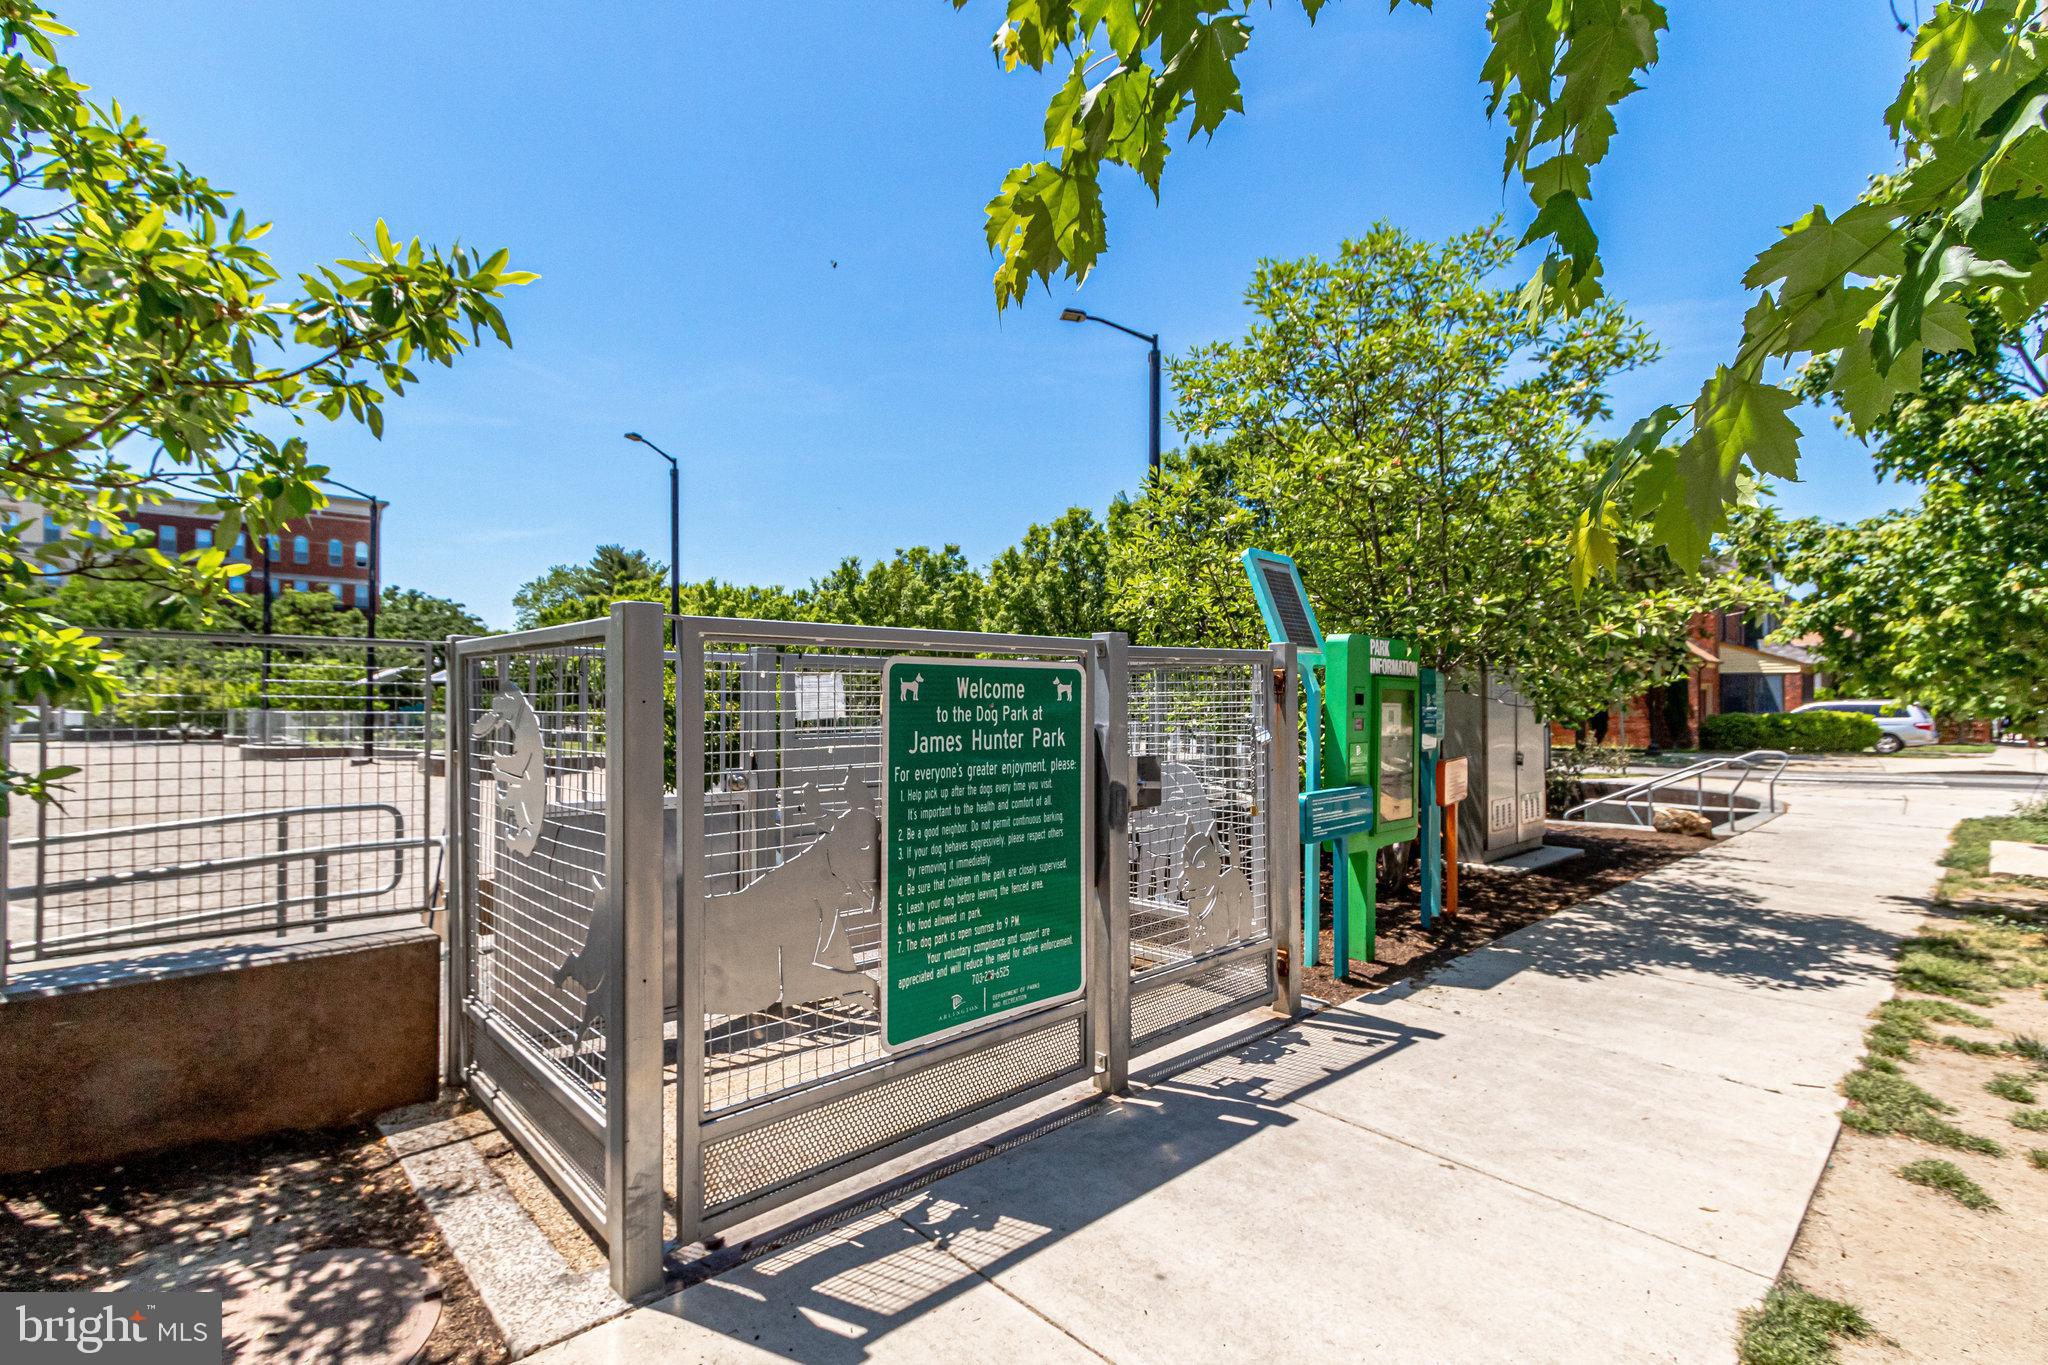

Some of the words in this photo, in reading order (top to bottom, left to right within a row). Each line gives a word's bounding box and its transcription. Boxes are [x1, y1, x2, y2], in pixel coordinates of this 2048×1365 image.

[1370, 639, 1390, 656] PARK
[1370, 657, 1418, 676] INFORMATION
[957, 677, 1025, 699] Welcome
[937, 706, 948, 722] to
[953, 706, 972, 722] the
[976, 705, 998, 726] Dog
[1003, 706, 1028, 721] Park
[1032, 705, 1043, 721] at
[908, 731, 963, 754] James
[972, 728, 1024, 750] Hunter
[1032, 727, 1066, 748] Park
[894, 766, 910, 782] For
[914, 762, 963, 783] everyone's
[967, 761, 998, 781] greater
[1050, 757, 1077, 774] please:
[907, 788, 922, 803] Help
[924, 787, 938, 802] pick
[940, 788, 949, 800] up
[951, 784, 965, 797] after
[967, 784, 977, 796] the
[979, 783, 993, 798] dogs
[995, 783, 1011, 795] every
[1013, 780, 1026, 791] time
[1027, 781, 1039, 793] you
[907, 808, 918, 820] It's
[920, 804, 951, 821] important
[954, 803, 961, 815] to
[963, 802, 973, 815] the
[976, 800, 995, 813] health
[997, 799, 1009, 811] and
[1011, 796, 1034, 809] comfort
[1035, 795, 1042, 807] of
[906, 827, 915, 840] Be
[917, 829, 922, 839] a
[923, 825, 939, 841] good
[941, 822, 968, 838] neighbor.
[970, 820, 979, 832] Do
[981, 818, 991, 831] not
[992, 816, 1011, 831] permit
[1012, 814, 1041, 827] continuous
[898, 847, 904, 860] 3.
[906, 846, 912, 859] If
[914, 846, 928, 861] your
[930, 843, 942, 857] dog
[944, 841, 968, 853] behaves
[1007, 833, 1025, 847] please
[1026, 828, 1046, 842] respect
[1047, 827, 1064, 839] others
[906, 883, 915, 896] Be
[917, 882, 931, 894] sure
[933, 877, 945, 891] that
[947, 875, 971, 888] children
[973, 873, 980, 883] in
[981, 870, 991, 882] the
[993, 867, 1006, 883] park
[1007, 867, 1017, 878] are
[1018, 863, 1037, 876] closely
[907, 865, 916, 880] by
[918, 860, 947, 875] removing
[949, 858, 954, 870] it
[898, 903, 904, 916] 5.
[906, 900, 925, 914] Leash
[927, 899, 941, 913] your
[943, 895, 955, 909] dog
[957, 891, 975, 904] before
[977, 886, 998, 901] leaving
[1000, 884, 1009, 896] the
[1011, 880, 1030, 894] fenced
[897, 922, 904, 935] 6.
[906, 919, 916, 933] No
[918, 916, 932, 931] food
[933, 910, 957, 927] allowed
[959, 910, 966, 921] in
[967, 906, 982, 922] park.
[897, 940, 904, 954] 7.
[906, 938, 918, 952] The
[920, 936, 932, 950] dog
[934, 931, 948, 947] park
[950, 930, 955, 941] is
[957, 927, 973, 941] open
[974, 922, 994, 936] sunrise
[996, 919, 1003, 931] to
[1004, 916, 1009, 928] 9
[926, 952, 941, 964] Your
[943, 945, 971, 960] voluntary
[973, 937, 1005, 953] compliance
[1007, 932, 1018, 945] and
[1019, 928, 1040, 942] support
[1041, 927, 1050, 937] are
[897, 968, 934, 990] appreciated
[936, 964, 948, 978] and
[950, 960, 961, 975] will
[963, 958, 983, 971] reduce
[985, 953, 995, 966] the
[996, 949, 1010, 962] need
[1012, 947, 1020, 958] for
[1022, 944, 1039, 956] active
[992, 987, 1019, 1001] DEPARTMENT
[1019, 985, 1026, 993] OF
[1002, 994, 1027, 1006] RECREATION
[939, 1005, 979, 1021] ARLINGTON
